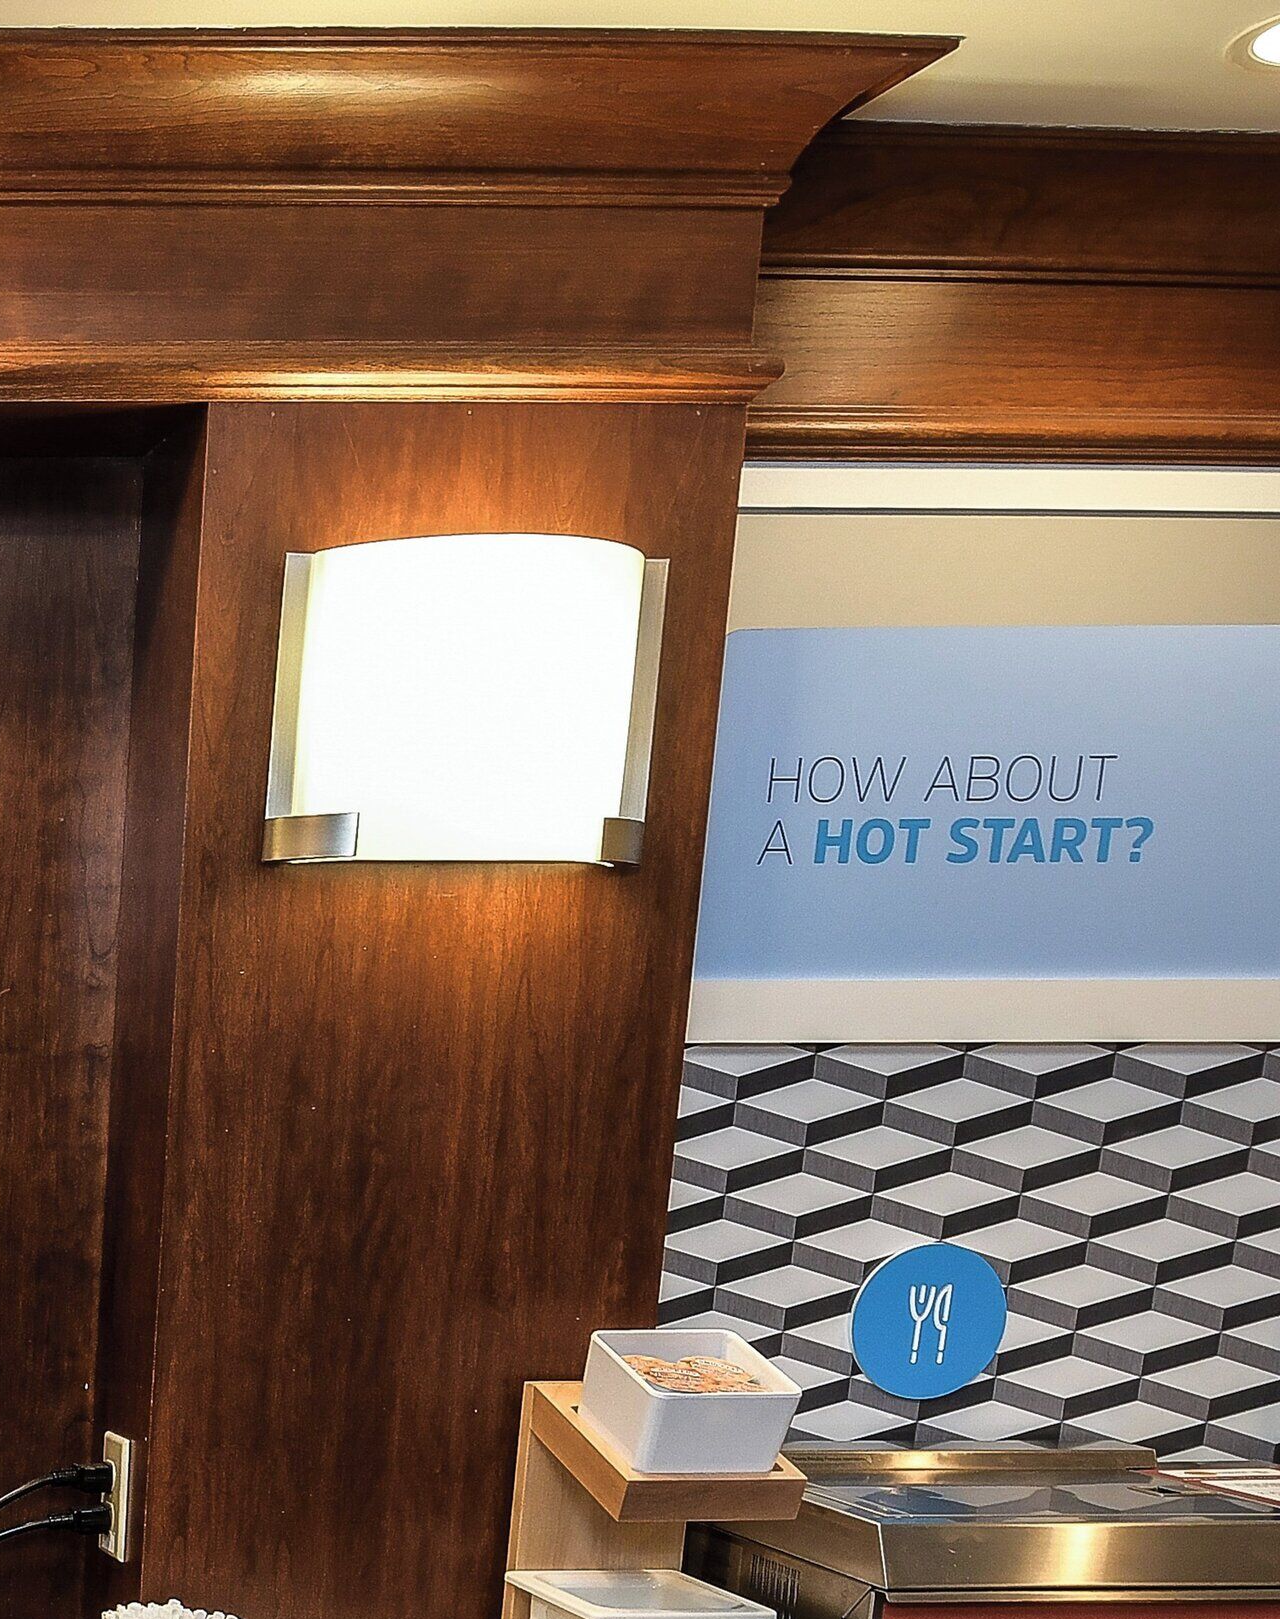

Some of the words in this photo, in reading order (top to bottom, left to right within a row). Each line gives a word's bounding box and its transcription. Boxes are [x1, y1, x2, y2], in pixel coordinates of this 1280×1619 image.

[766, 754, 907, 803] HOW
[923, 754, 1119, 803] ABOUT
[756, 819, 794, 866] A
[813, 818, 931, 865] HOT
[945, 816, 1155, 865] START?
